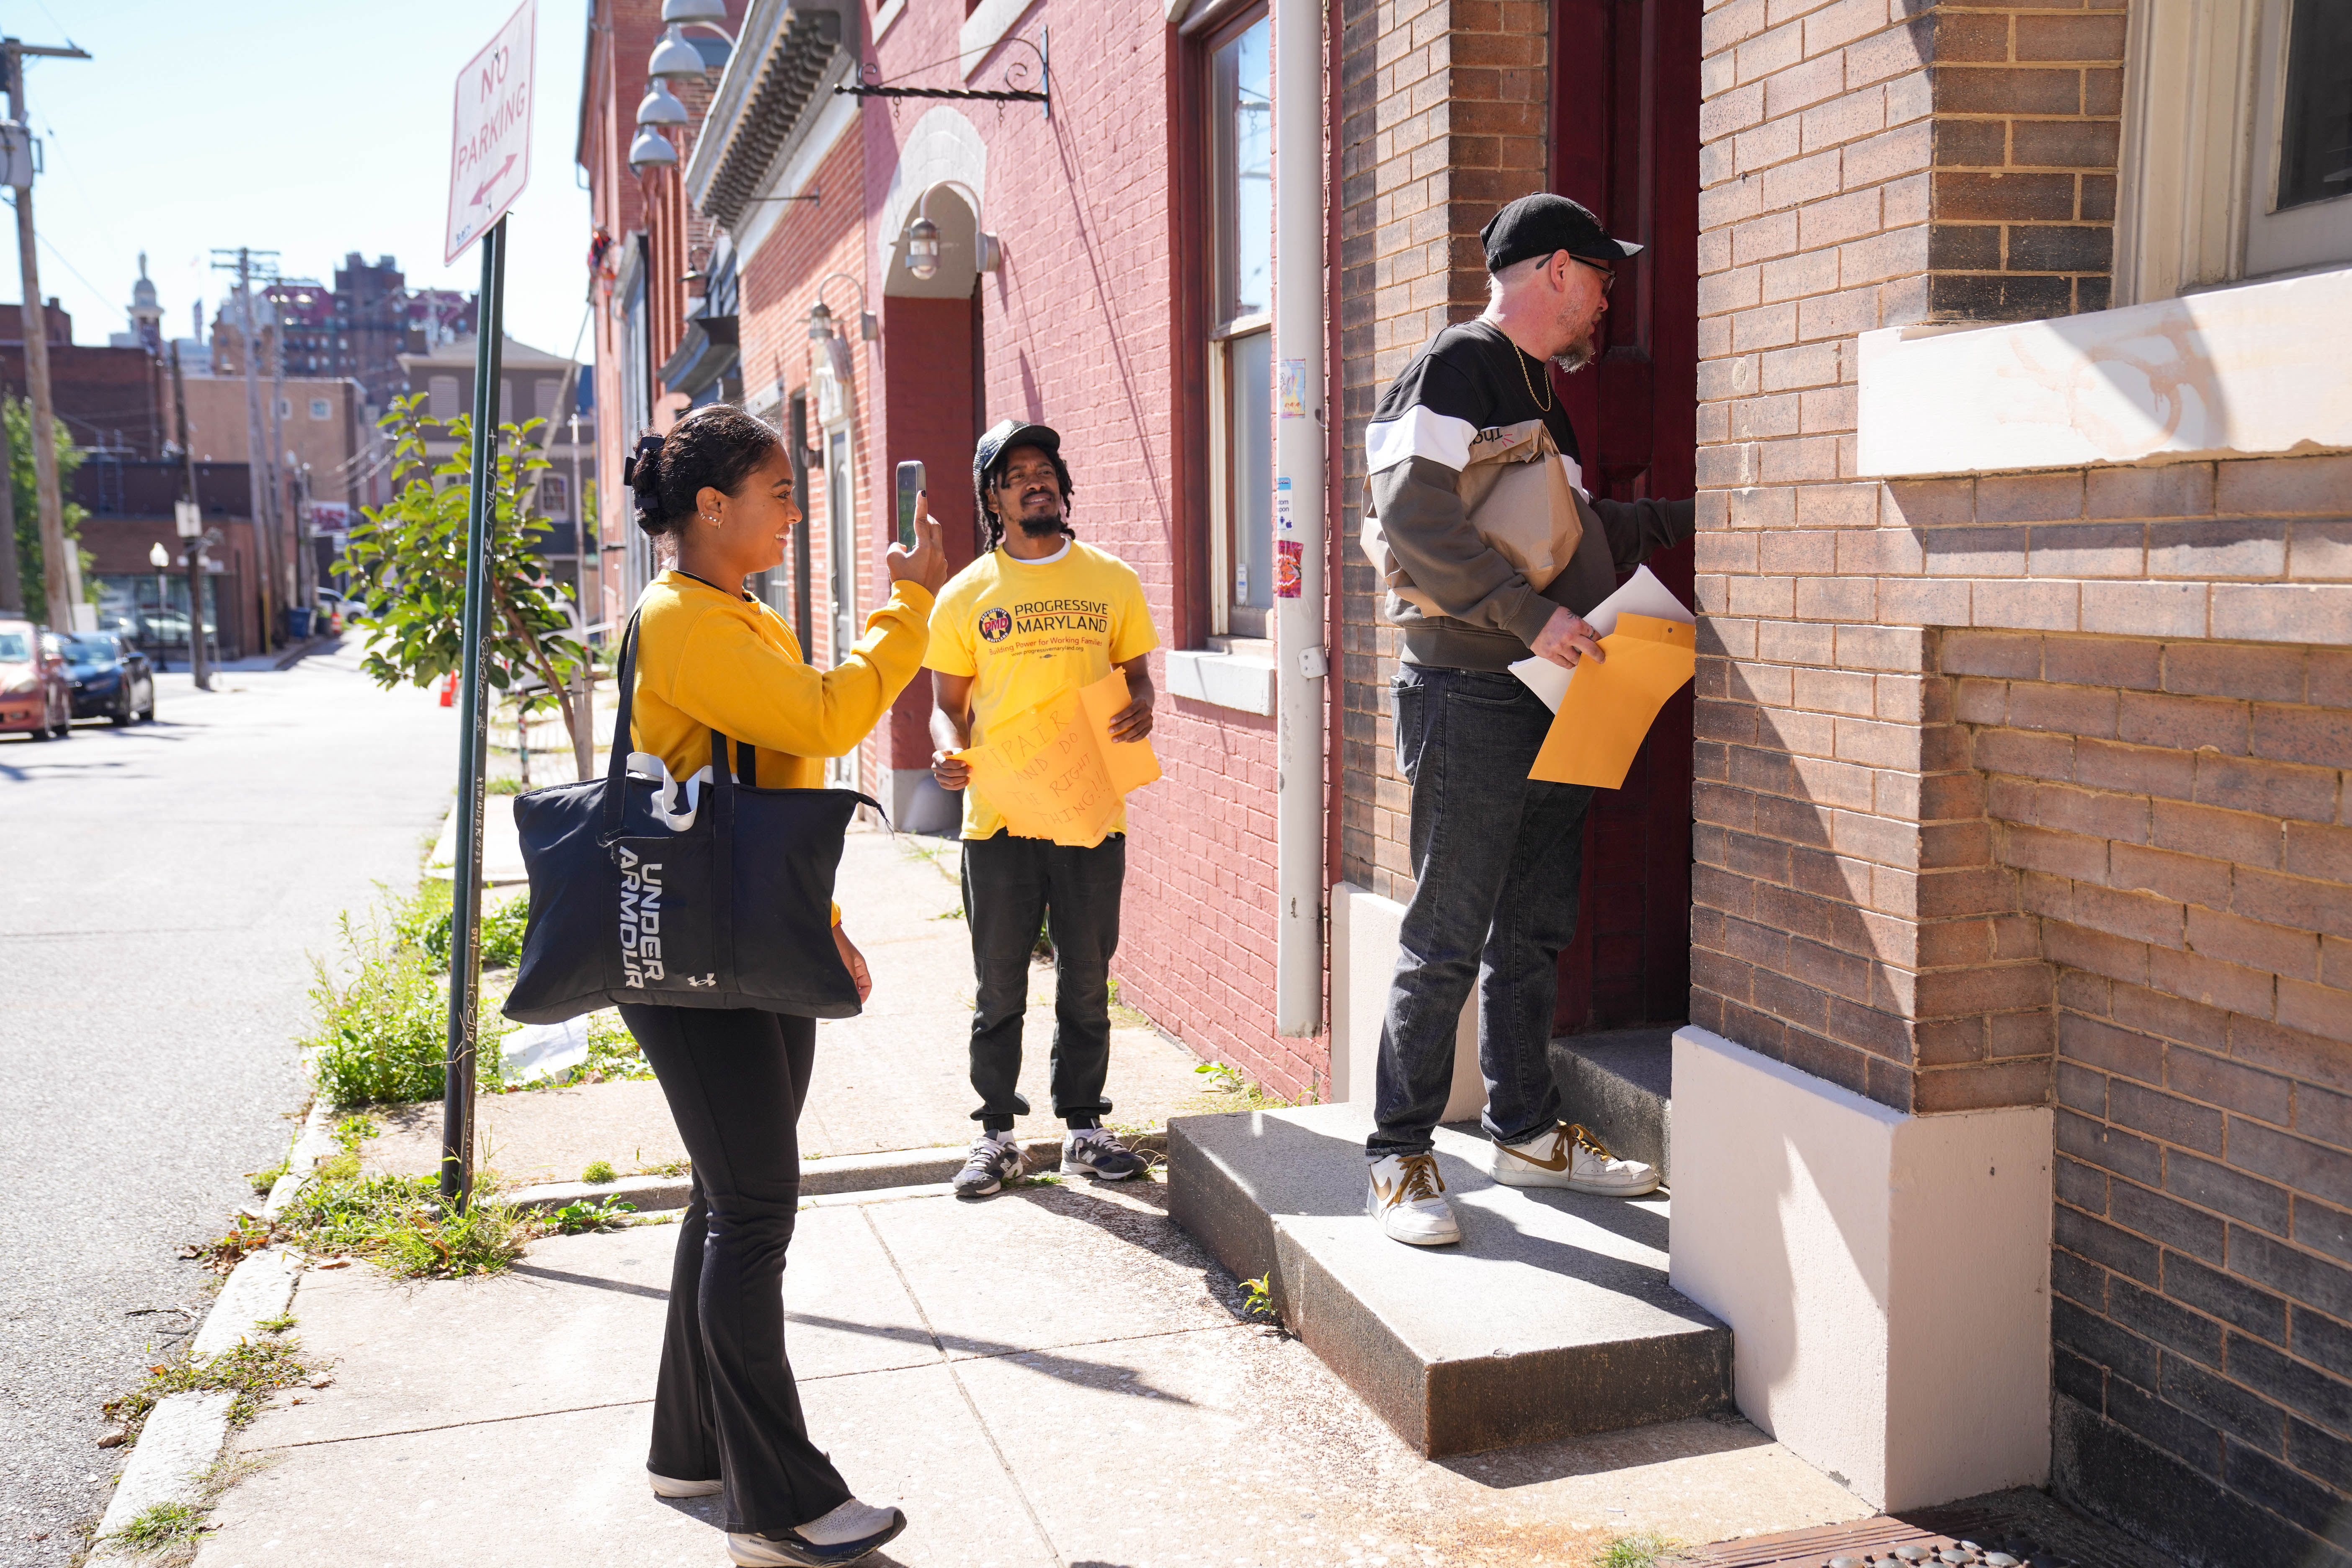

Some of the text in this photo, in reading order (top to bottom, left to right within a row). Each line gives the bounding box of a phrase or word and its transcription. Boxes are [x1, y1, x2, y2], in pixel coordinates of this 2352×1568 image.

[481, 45, 508, 103] NO
[458, 82, 525, 181] PARKING
[1469, 428, 1503, 446] Tha
[980, 608, 1007, 621] PROGRESSIVE
[1015, 600, 1109, 616] PROGRESSIVE
[985, 617, 1008, 634] PMD
[1017, 616, 1107, 634] MARYLAND
[987, 632, 1008, 642] MARYLAND
[989, 645, 1014, 655] Building
[1050, 637, 1079, 645] Working
[1081, 637, 1102, 646] Families
[1011, 646, 1084, 657] www.progressivemaryland.org
[975, 711, 1069, 771] REPAIR
[1014, 733, 1078, 784] AND DO
[1050, 753, 1090, 797] RIGHT
[619, 846, 644, 988] ARMOUR
[640, 863, 665, 980] UNDER
[1081, 1150, 1096, 1164] N
